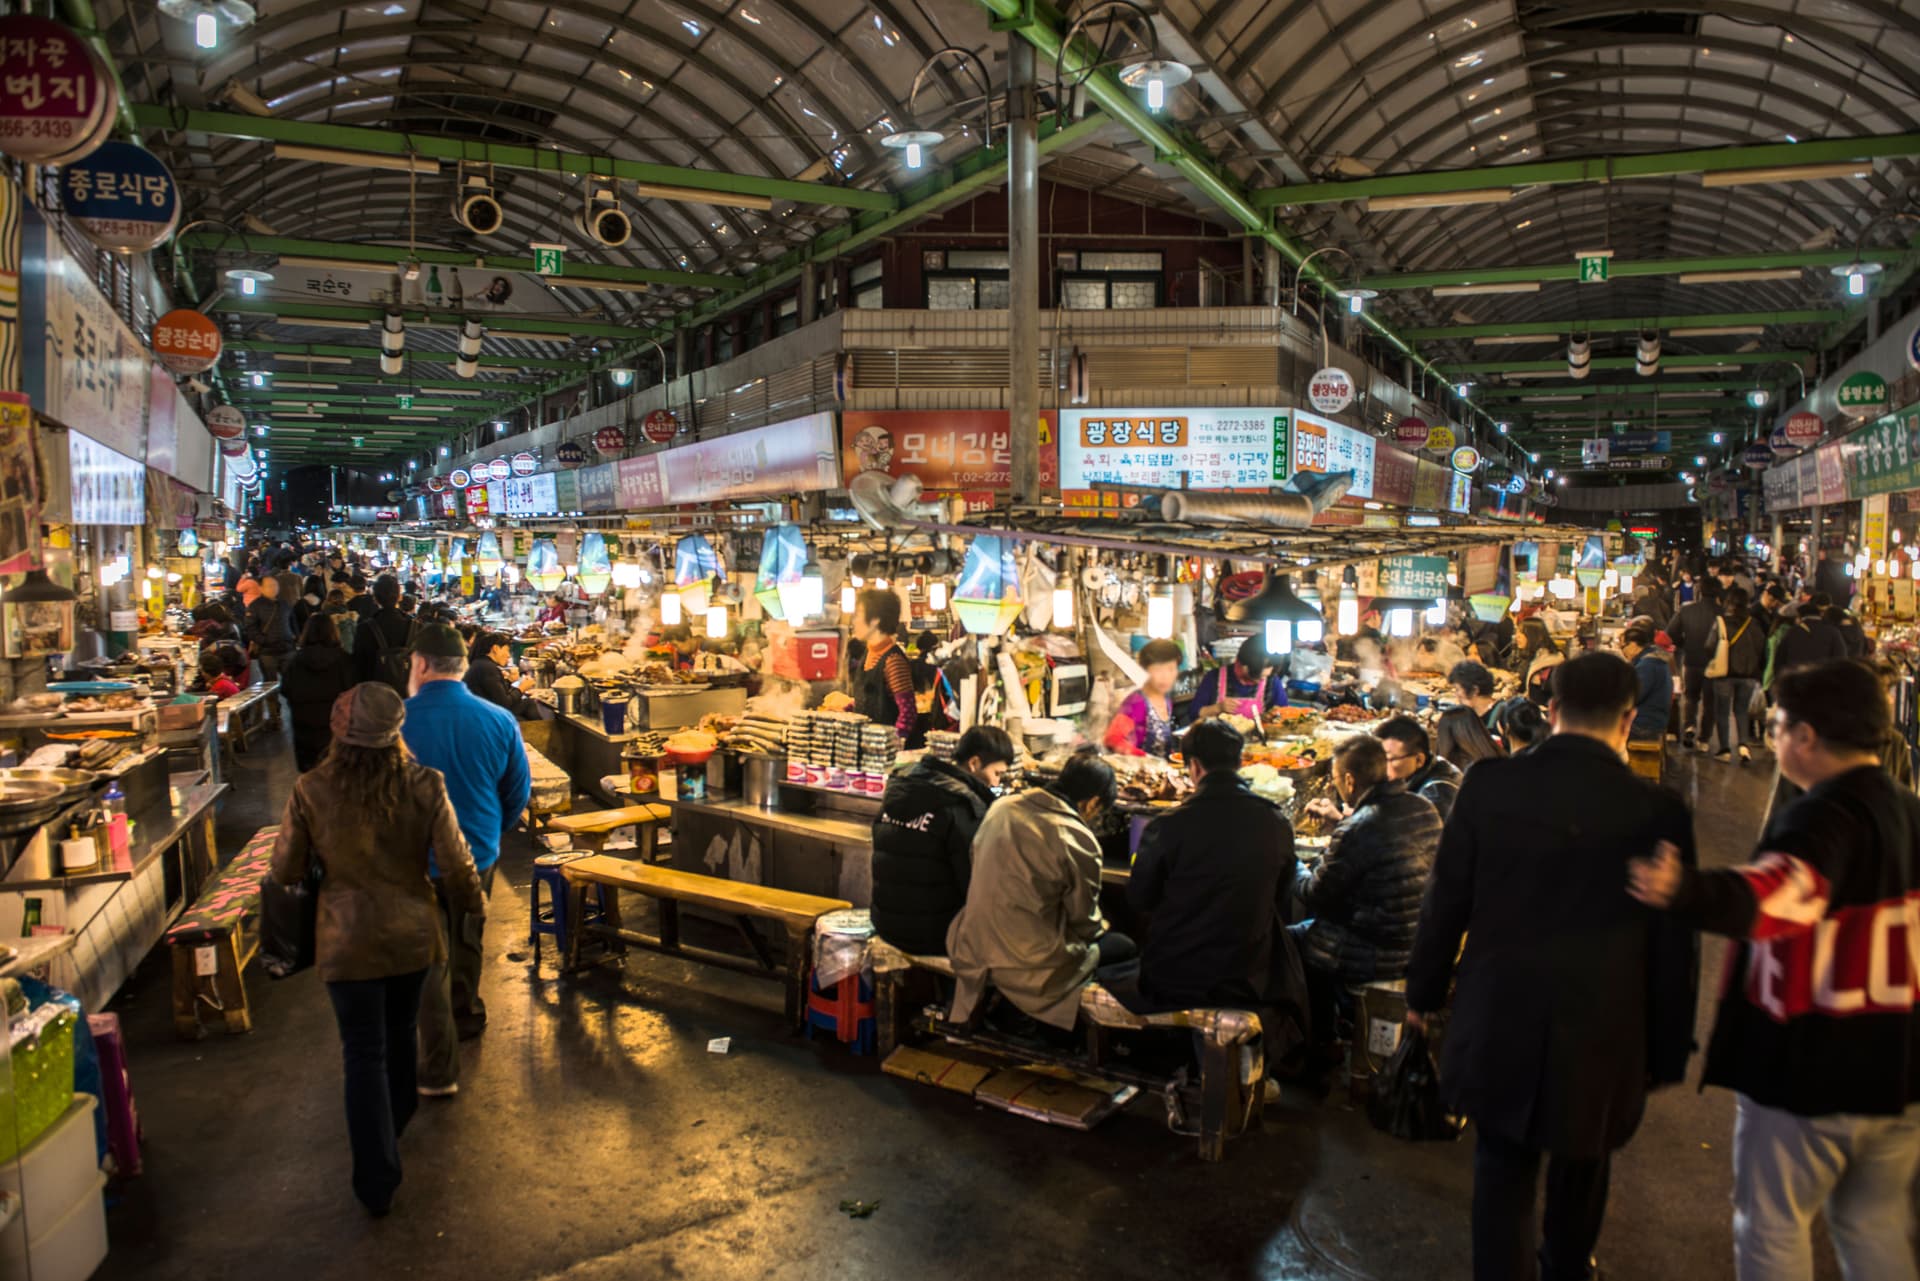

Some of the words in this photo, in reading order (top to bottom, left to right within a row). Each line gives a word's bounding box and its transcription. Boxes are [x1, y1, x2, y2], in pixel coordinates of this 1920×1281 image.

[67, 169, 169, 207] 종로식당
[306, 278, 352, 296] 국순당
[157, 327, 218, 352] 광장순대
[1086, 421, 1181, 444] 광장식당
[1229, 452, 1269, 465] 아구탕
[1404, 570, 1445, 586] 잔치국수
